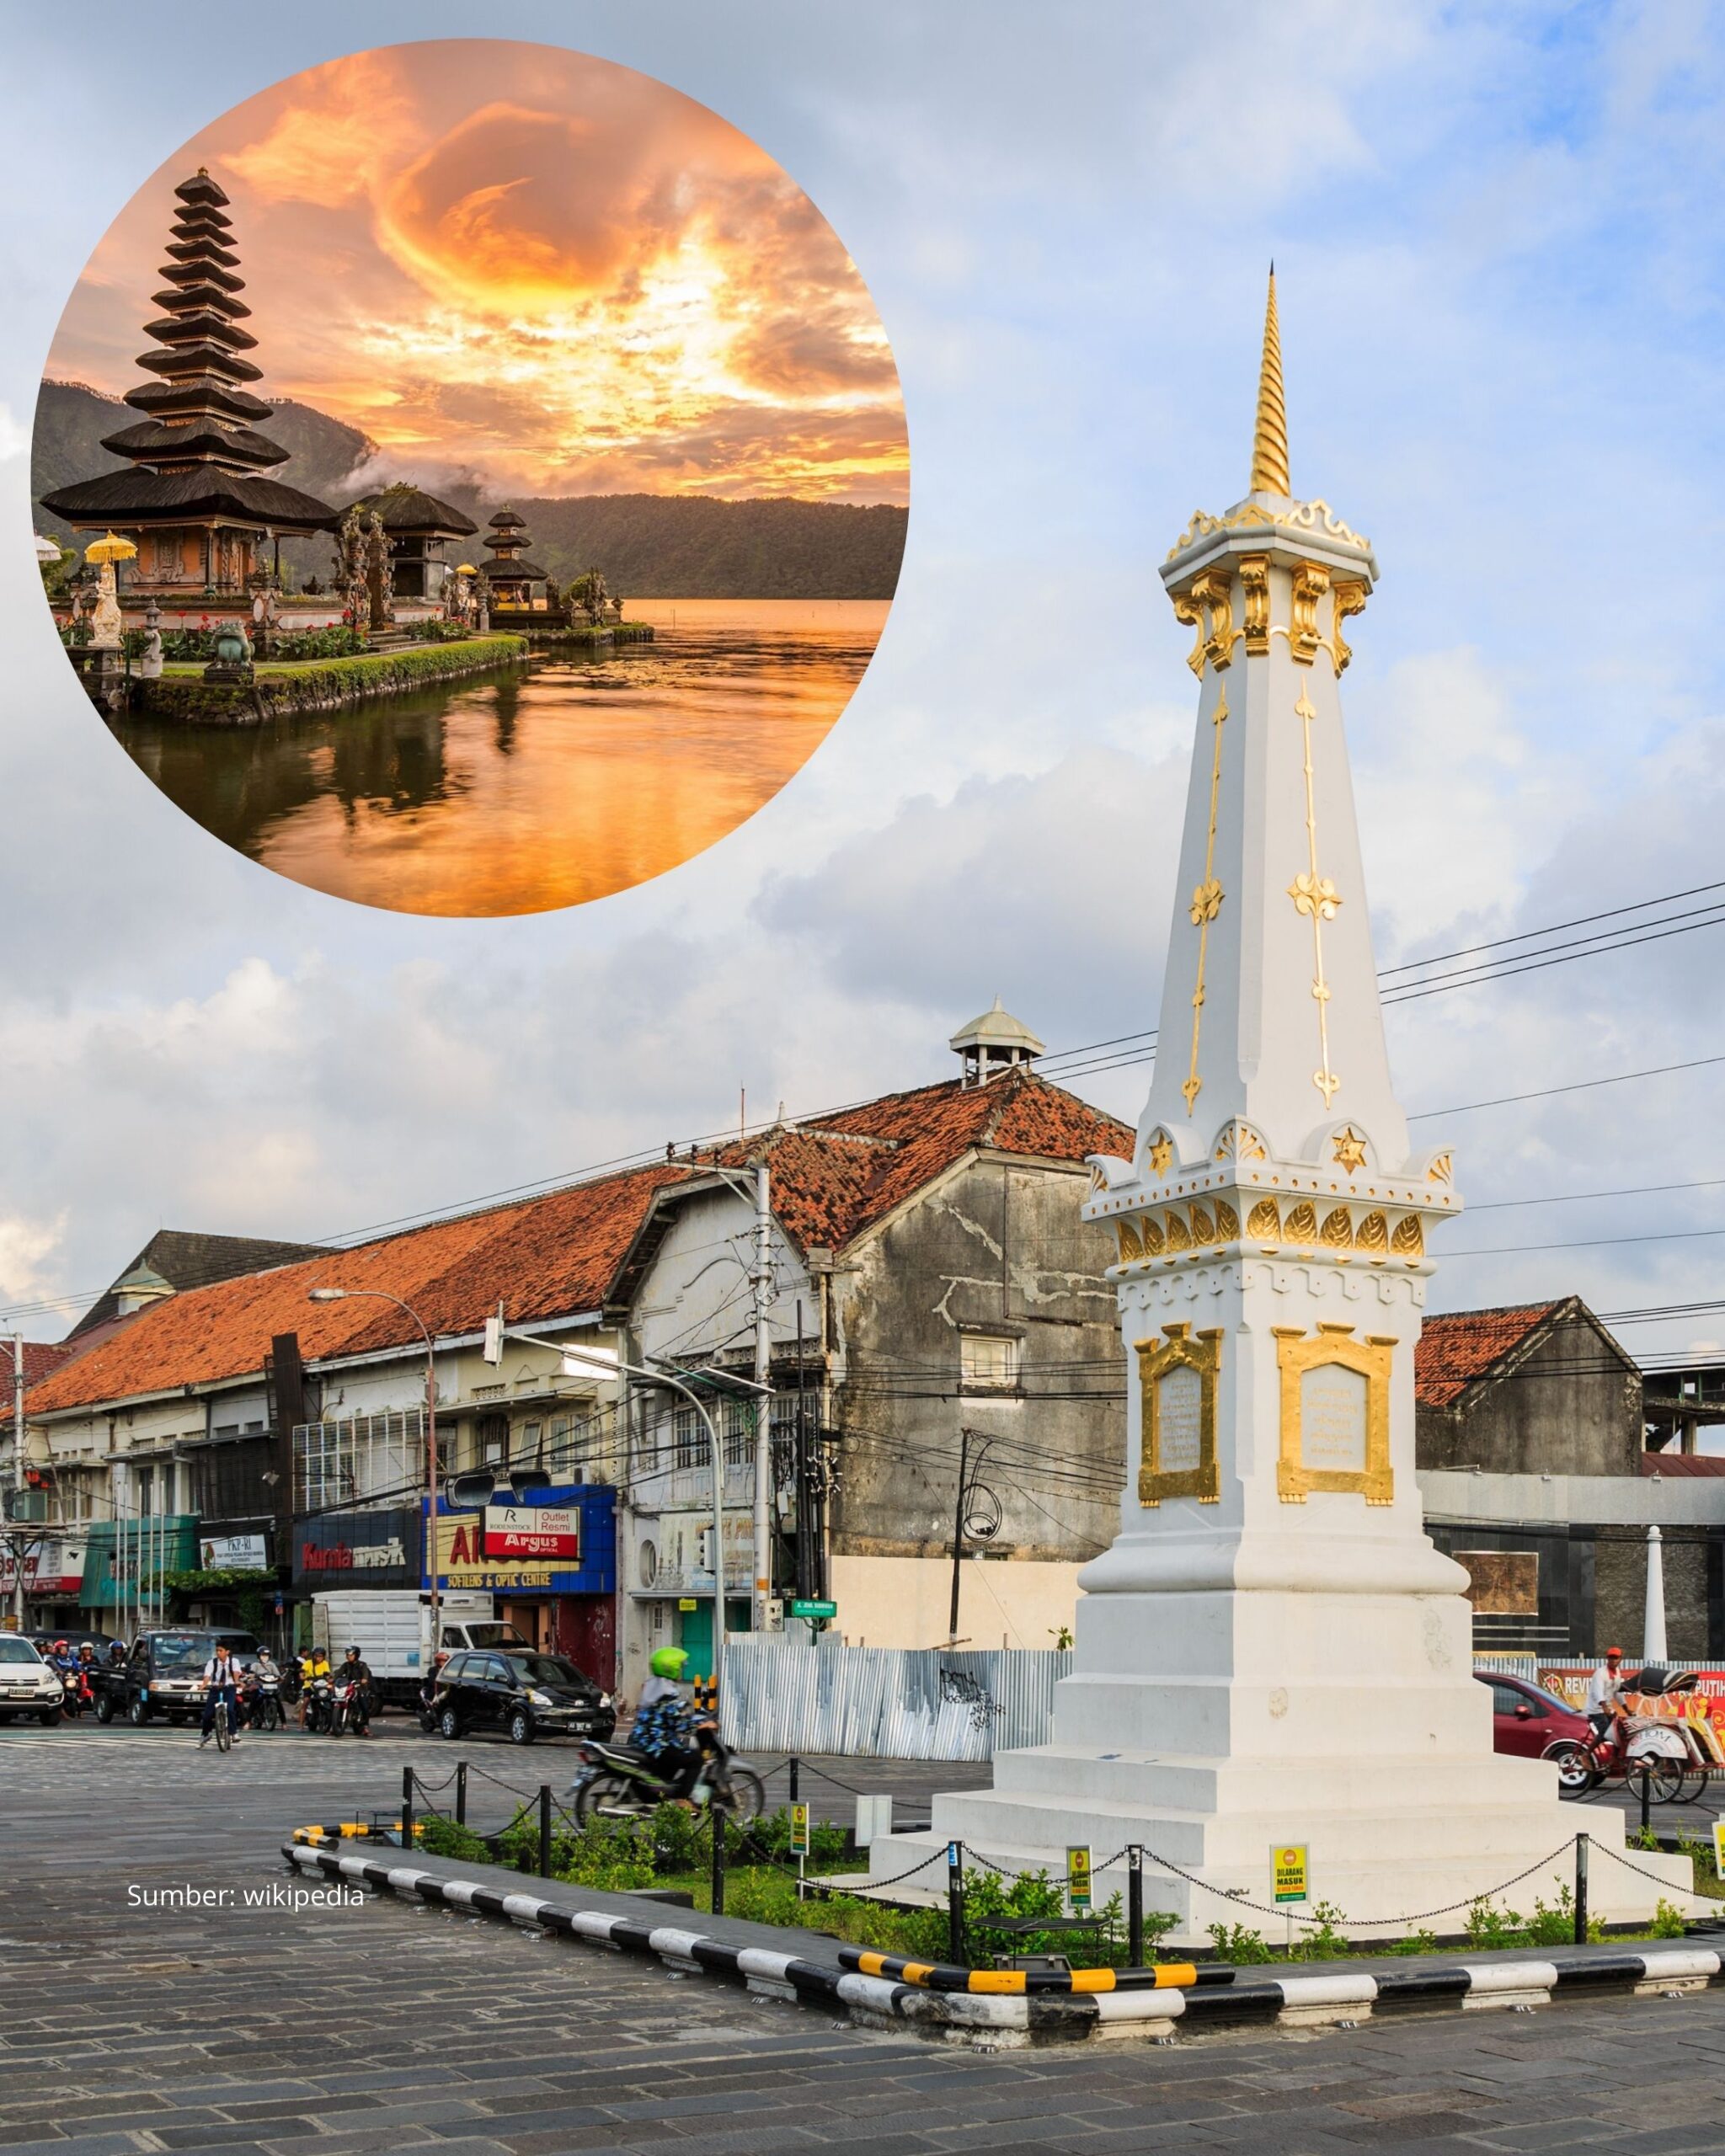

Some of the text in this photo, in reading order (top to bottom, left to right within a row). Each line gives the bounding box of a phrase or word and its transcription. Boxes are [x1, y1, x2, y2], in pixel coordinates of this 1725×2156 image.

[541, 1512, 569, 1522] Outlet
[489, 1523, 531, 1531] RODENSTOCK
[541, 1522, 570, 1532] Resmi
[505, 1534, 558, 1552] Argus
[302, 1542, 353, 1571] Kurnia
[486, 1574, 493, 1588] &
[495, 1573, 519, 1588] OPTIC
[521, 1572, 552, 1587] CENTRE
[1276, 1867, 1304, 1877] DILARANG
[1276, 1876, 1304, 1886] MASUK
